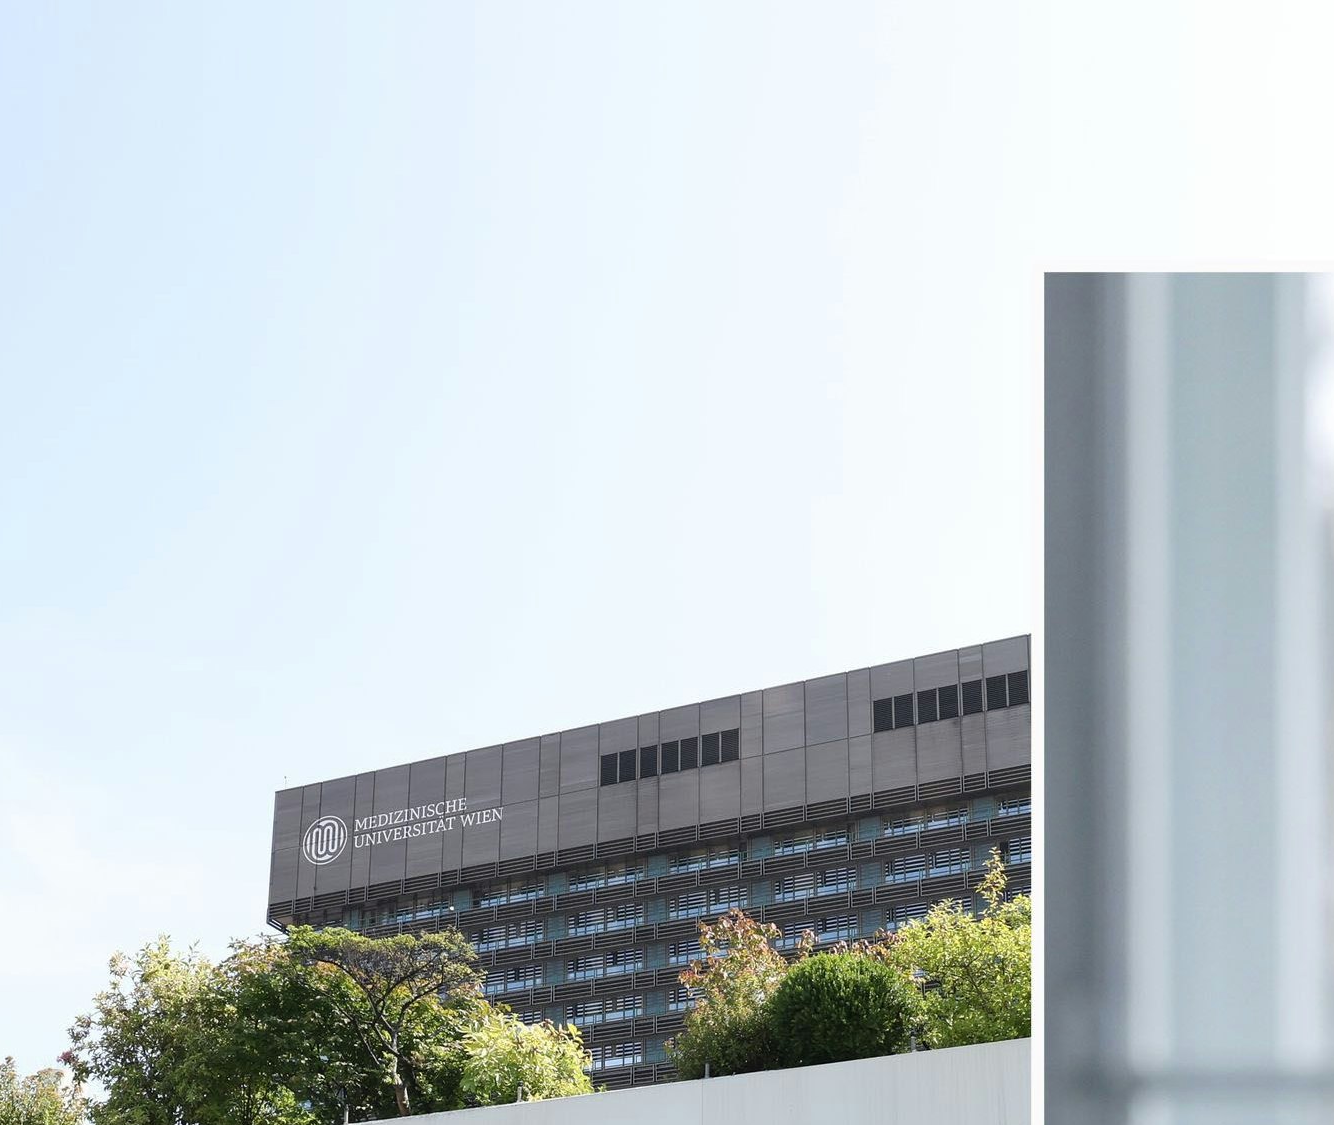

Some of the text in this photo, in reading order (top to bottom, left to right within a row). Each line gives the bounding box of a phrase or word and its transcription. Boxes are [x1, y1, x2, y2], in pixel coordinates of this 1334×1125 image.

[353, 807, 504, 849] UNIVERSITÄT WIEN
[354, 798, 468, 832] MEDIZINISCHE
